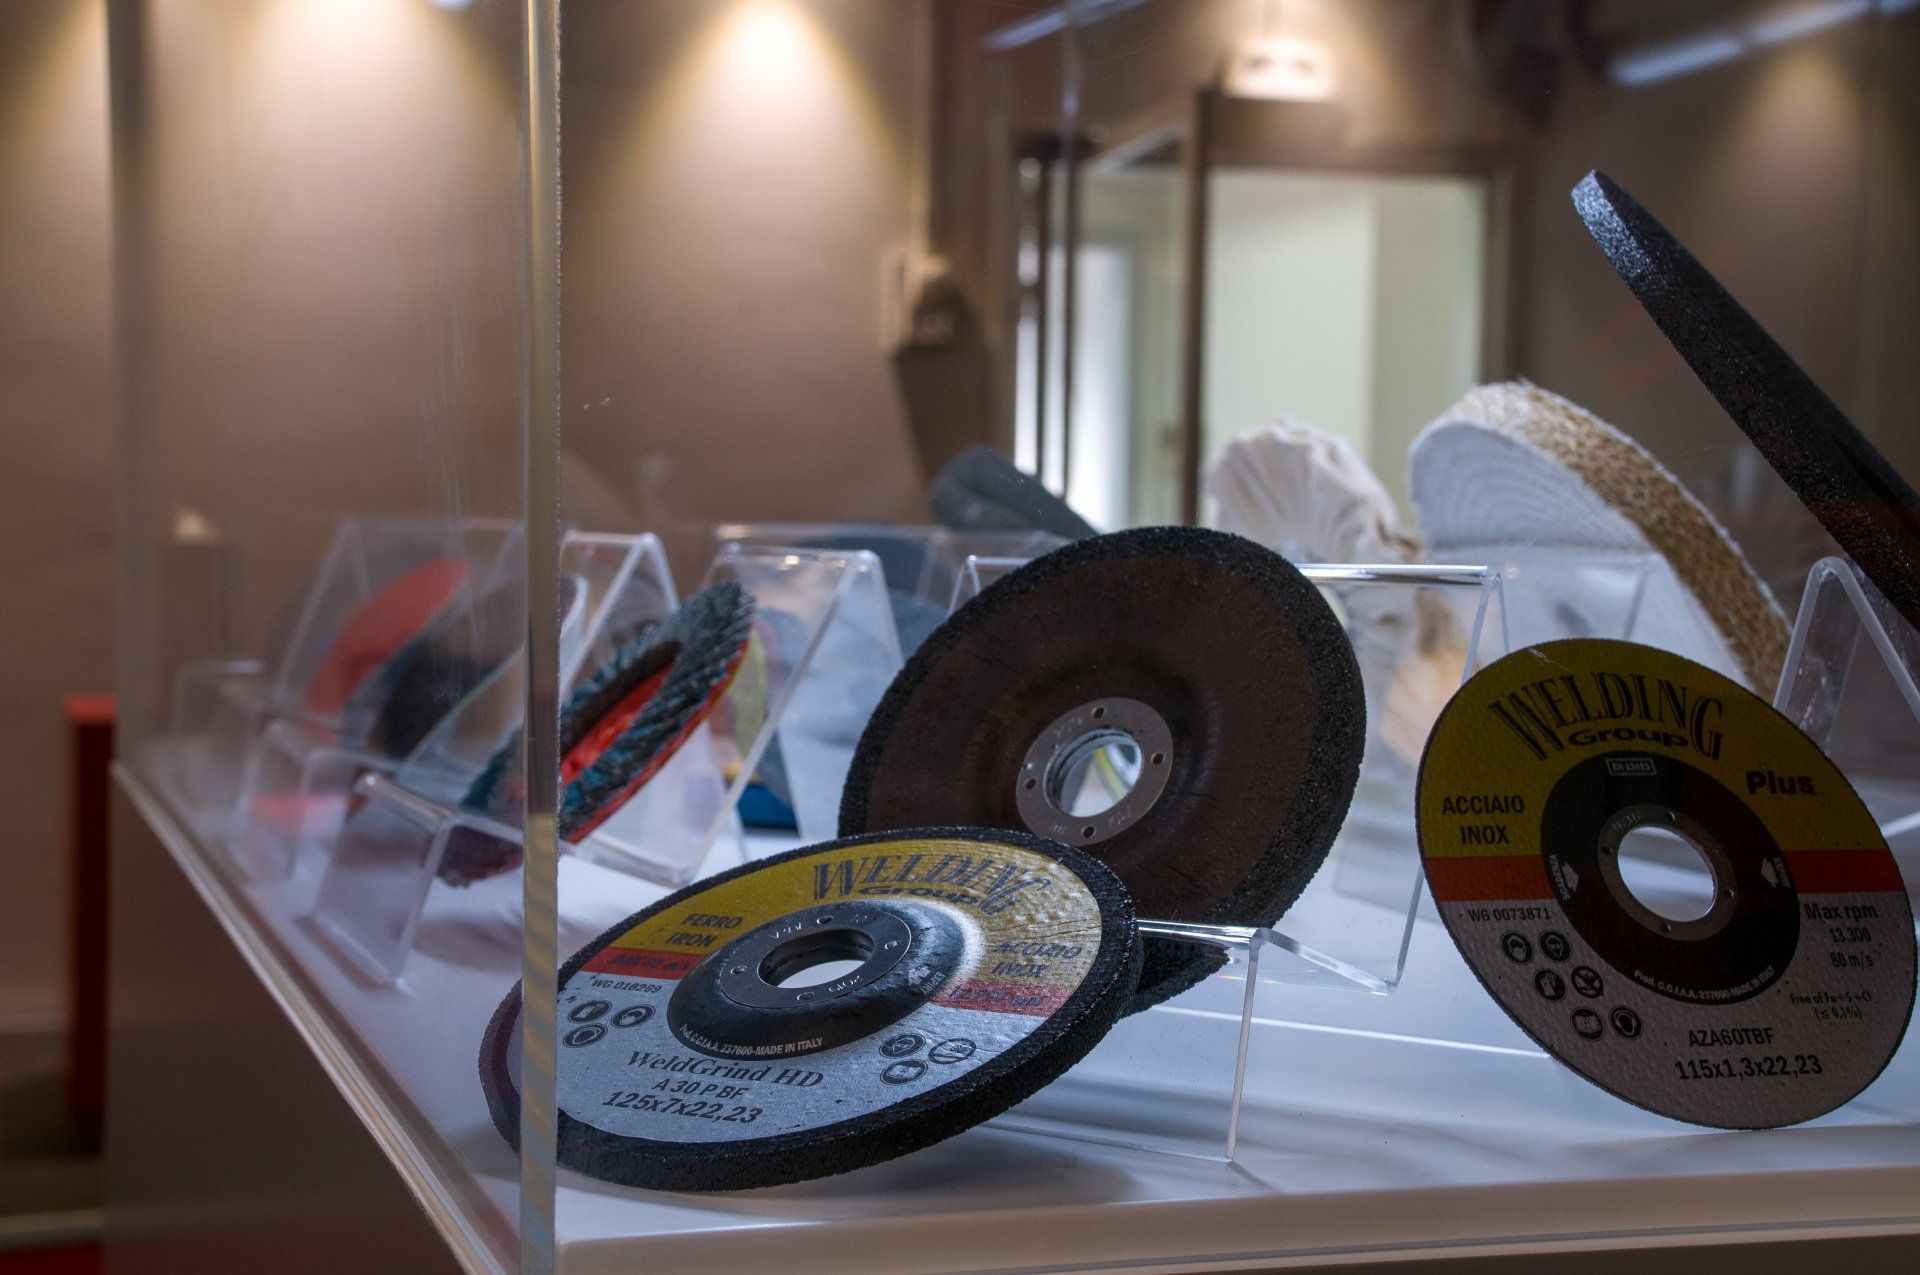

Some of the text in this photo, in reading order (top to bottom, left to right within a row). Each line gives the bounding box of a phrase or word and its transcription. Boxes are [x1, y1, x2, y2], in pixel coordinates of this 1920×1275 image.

[1488, 671, 1723, 761] WELDING
[1569, 727, 1690, 748] Group
[1746, 770, 1816, 796] Plus
[1442, 796, 1525, 815] ACCIAIO
[1460, 826, 1510, 845] INOX
[813, 854, 1051, 916] WELDING
[859, 885, 980, 904] Group
[681, 913, 744, 929] FERRO
[1468, 908, 1551, 922] WG 0073871
[1804, 903, 1878, 922] Max rpm
[665, 932, 718, 948] IRON
[1829, 927, 1872, 943] 13.300
[1830, 952, 1875, 971] 80 m/s
[784, 1042, 796, 1053] IN
[797, 1037, 823, 1050] ITALY
[1689, 1027, 1774, 1047] AZA60TBF
[626, 1051, 824, 1087] WeldGrind HD
[1676, 1055, 1823, 1081] 115x1,3x22,23
[652, 1078, 671, 1091] A
[671, 1080, 699, 1093] 30
[602, 1091, 764, 1124] 125x7x22,23
